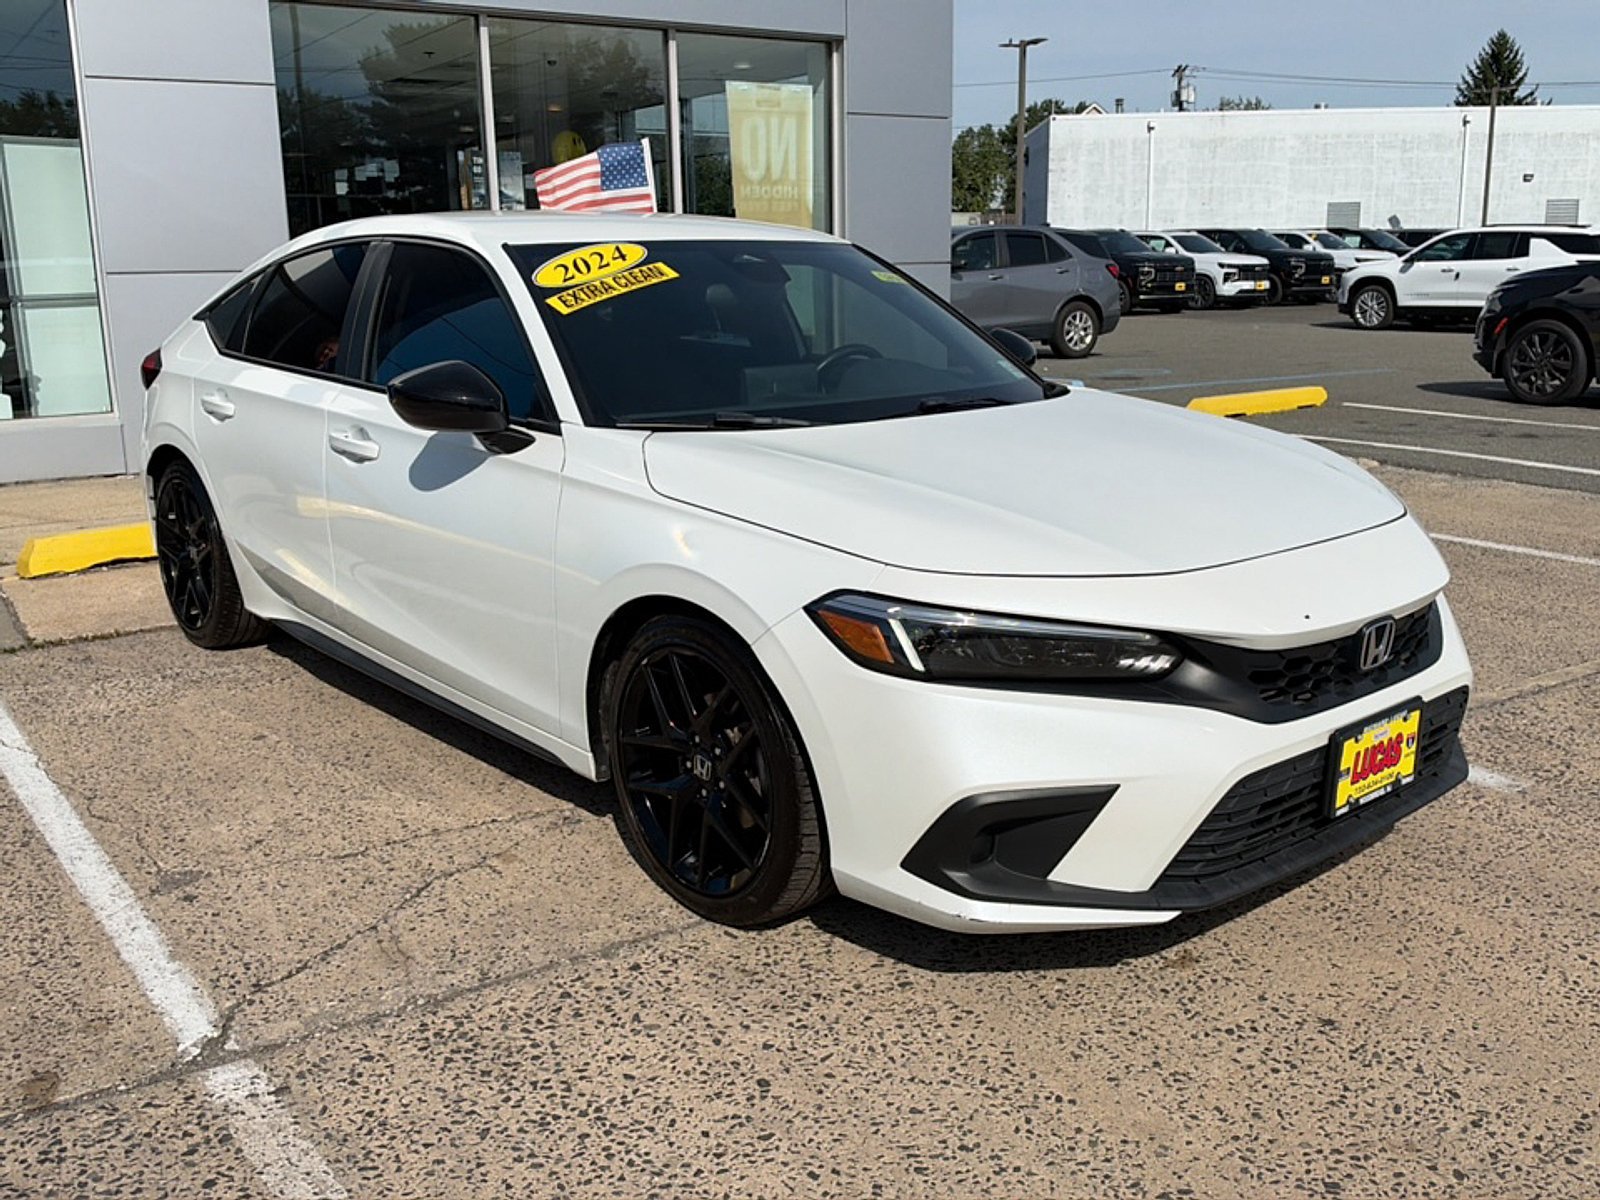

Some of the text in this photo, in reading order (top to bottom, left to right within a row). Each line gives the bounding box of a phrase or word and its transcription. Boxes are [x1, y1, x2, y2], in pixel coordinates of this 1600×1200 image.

[553, 245, 628, 284] 2024
[557, 265, 665, 308] EXTRA CLEAN
[1350, 732, 1404, 785] LUCAS
